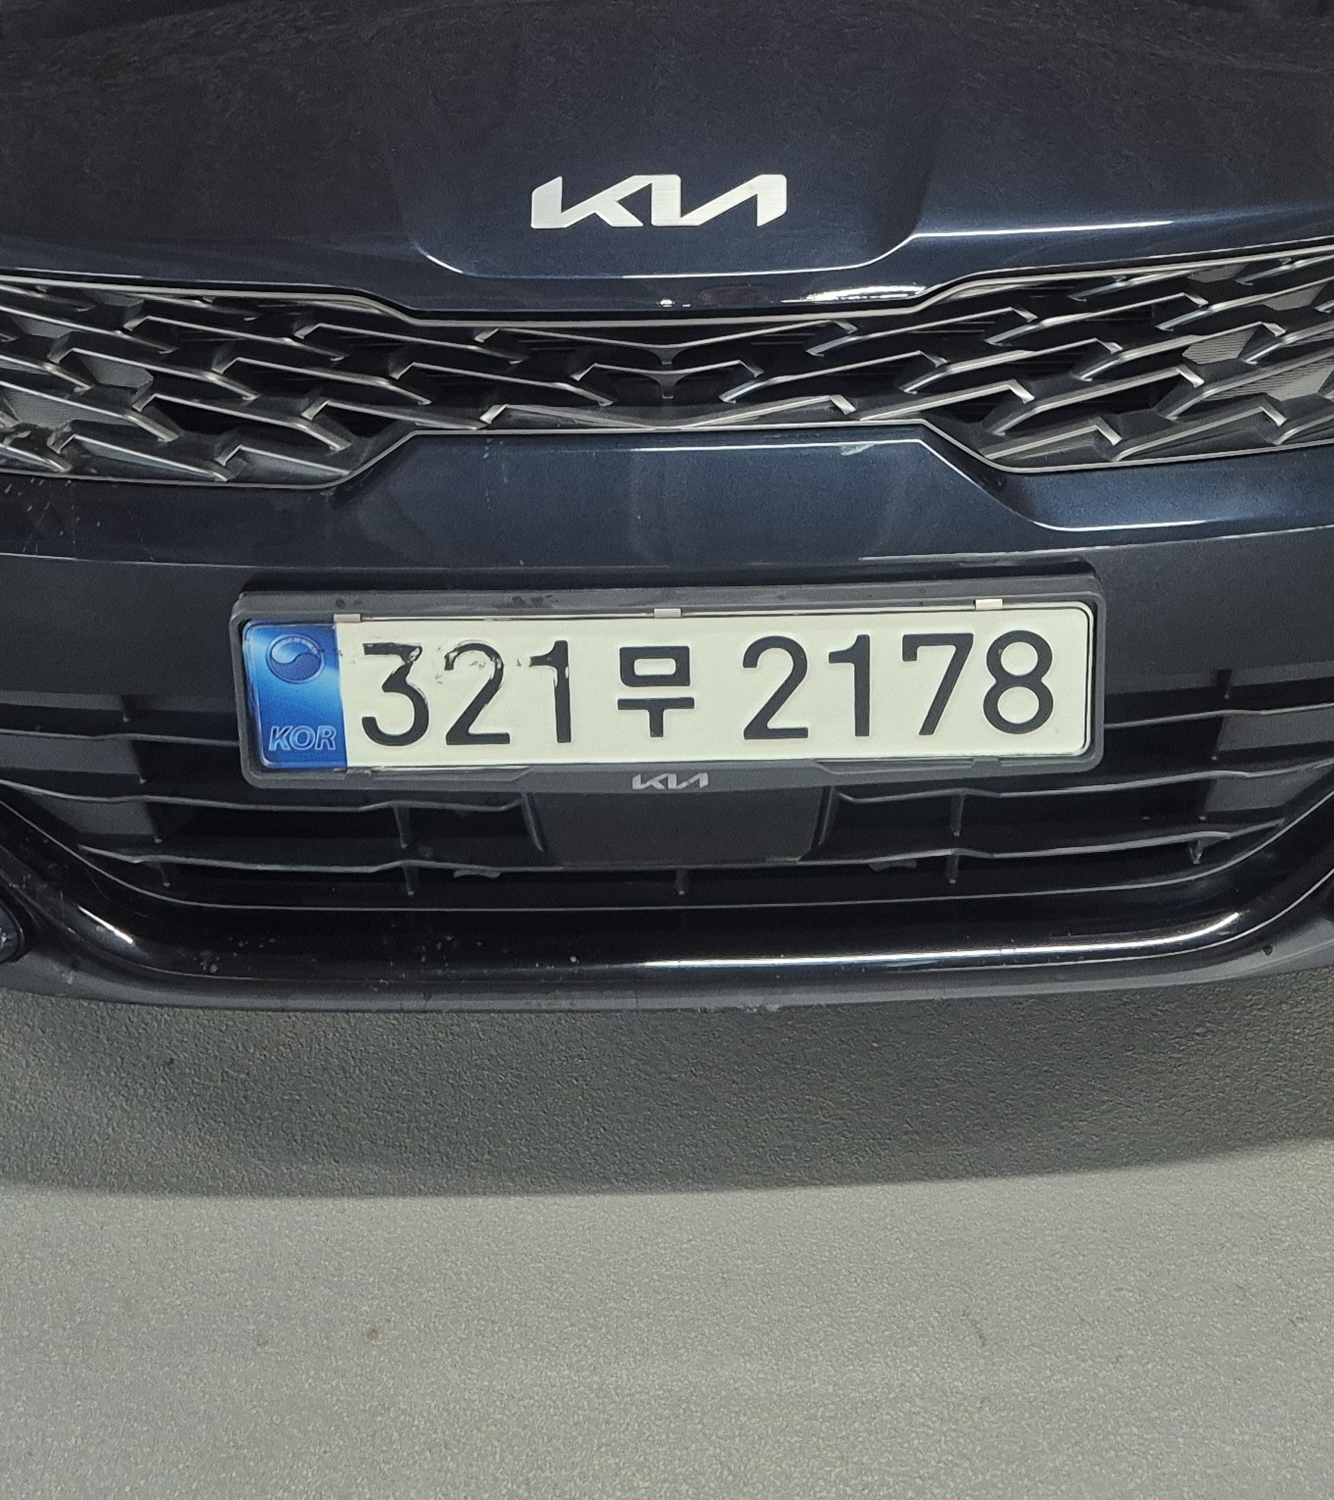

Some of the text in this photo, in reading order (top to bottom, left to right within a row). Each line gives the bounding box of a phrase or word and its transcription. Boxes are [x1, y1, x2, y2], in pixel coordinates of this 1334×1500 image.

[531, 174, 787, 229] KIA
[742, 630, 1054, 740] 2178
[268, 726, 337, 751] KOR
[632, 772, 709, 790] KIA
